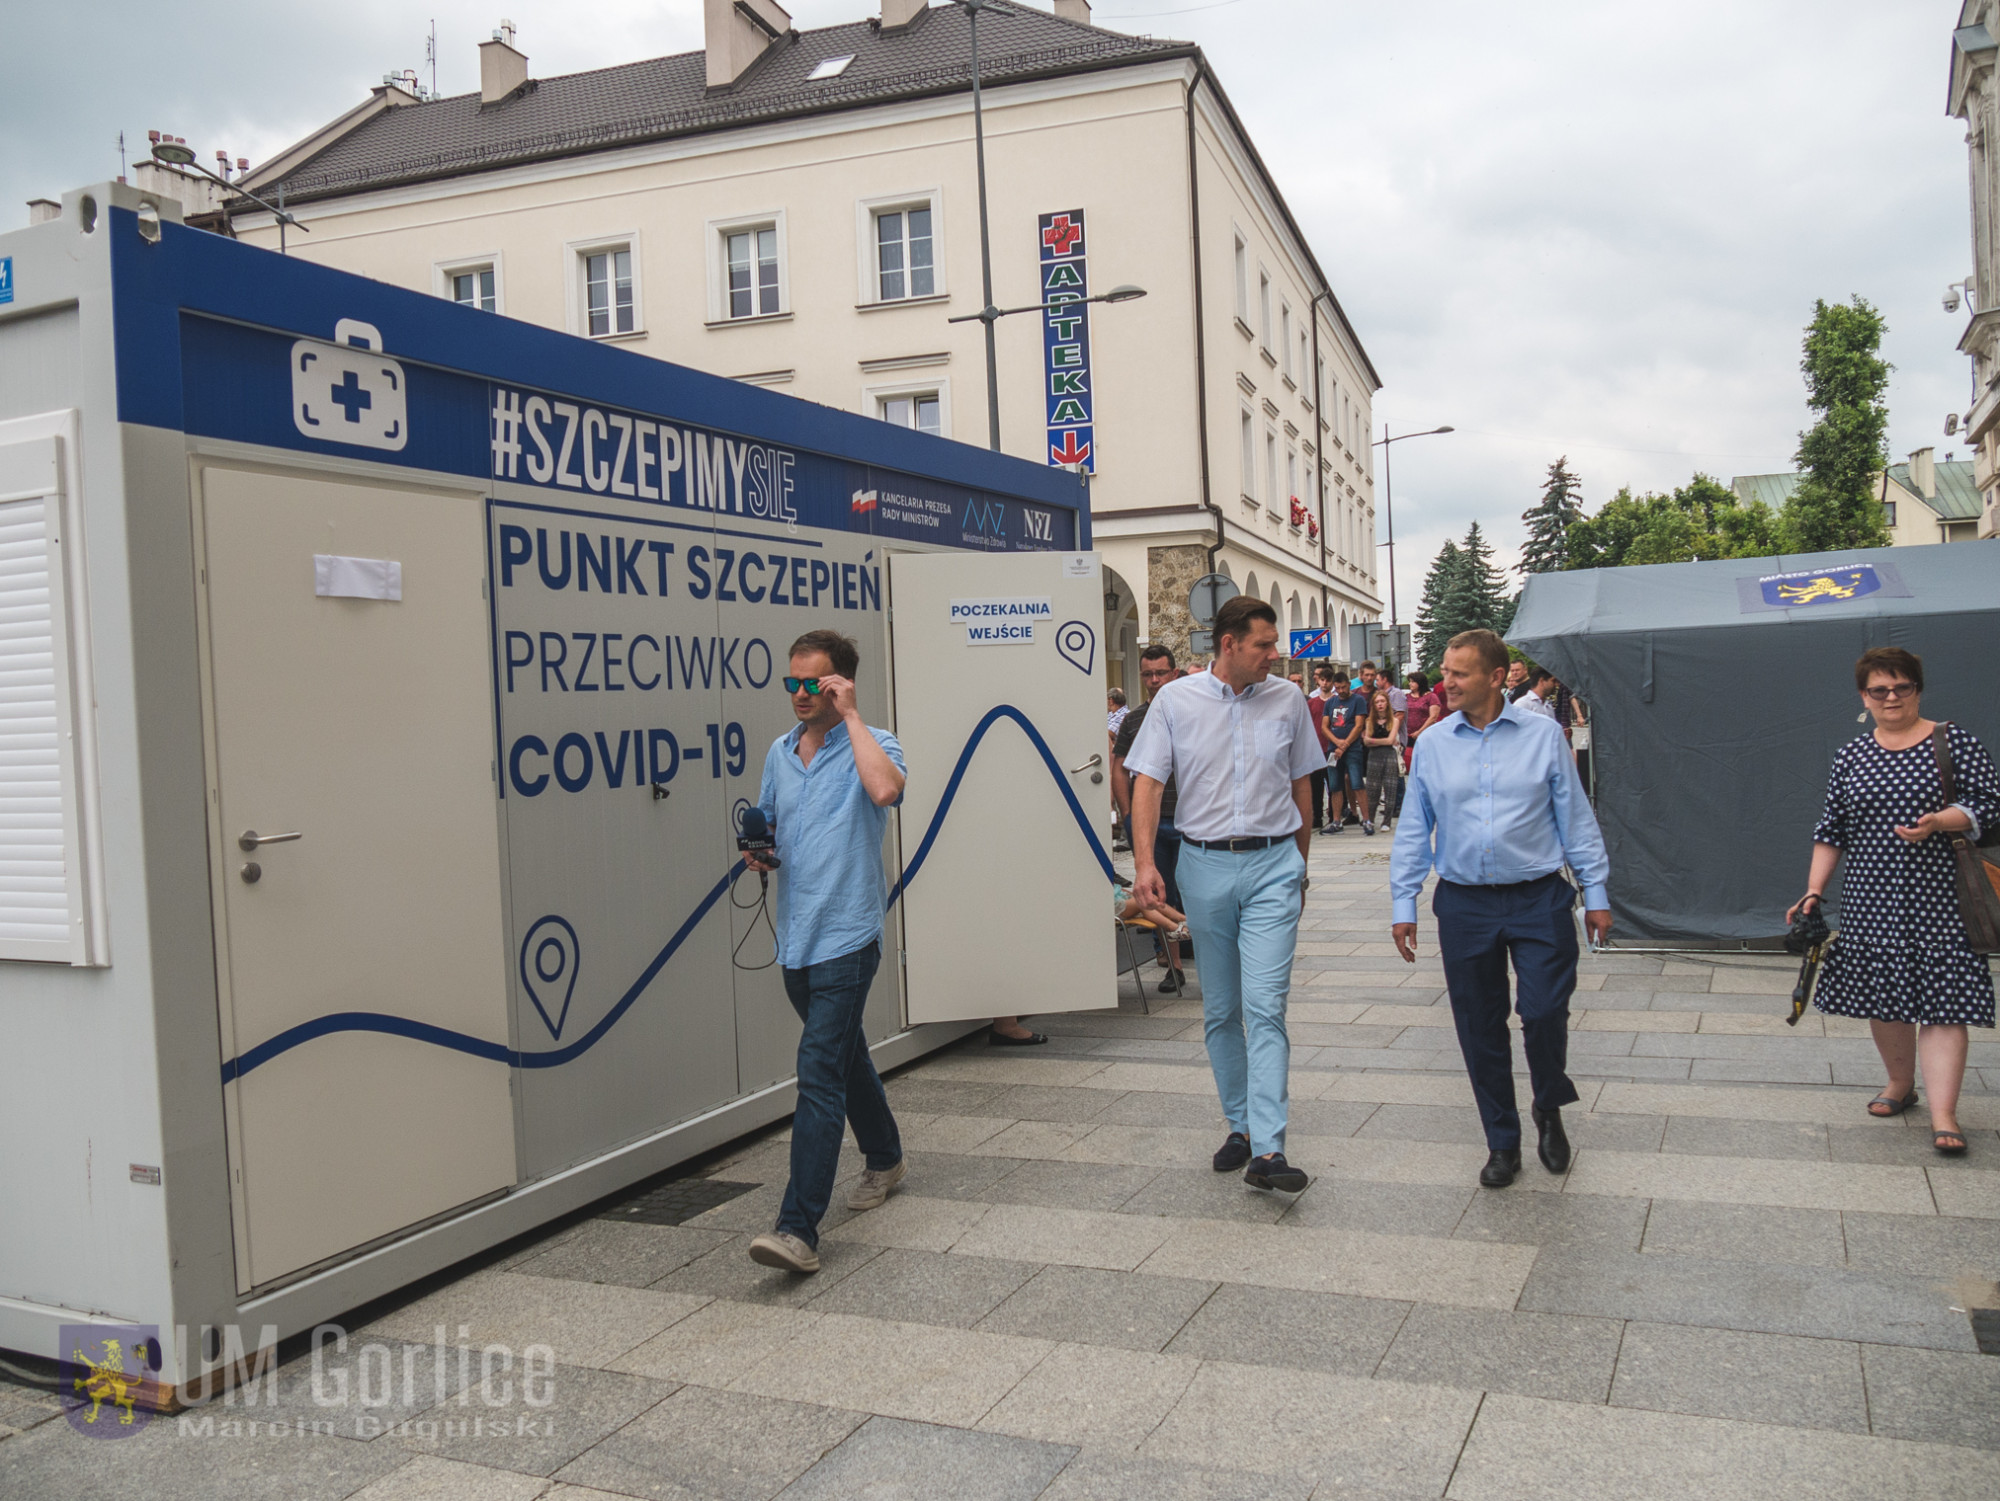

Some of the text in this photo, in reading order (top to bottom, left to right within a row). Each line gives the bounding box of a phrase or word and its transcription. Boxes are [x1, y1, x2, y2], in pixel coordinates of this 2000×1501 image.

[1045, 263, 1088, 423] APTEKA
[881, 491, 952, 514] KANCELARIA PREZESA
[882, 507, 939, 527] RADY MINISTRÓW
[1023, 508, 1053, 541] NFZ
[500, 524, 881, 611] PUNKT SZCZEPIEŃ
[1759, 563, 1873, 582] MIASTO GORLICE
[951, 603, 1050, 617] POCZEKALNIA
[968, 623, 1033, 639] WEJŚCIE
[505, 630, 772, 693] PRZECIWKO
[508, 722, 746, 797] COVID-19
